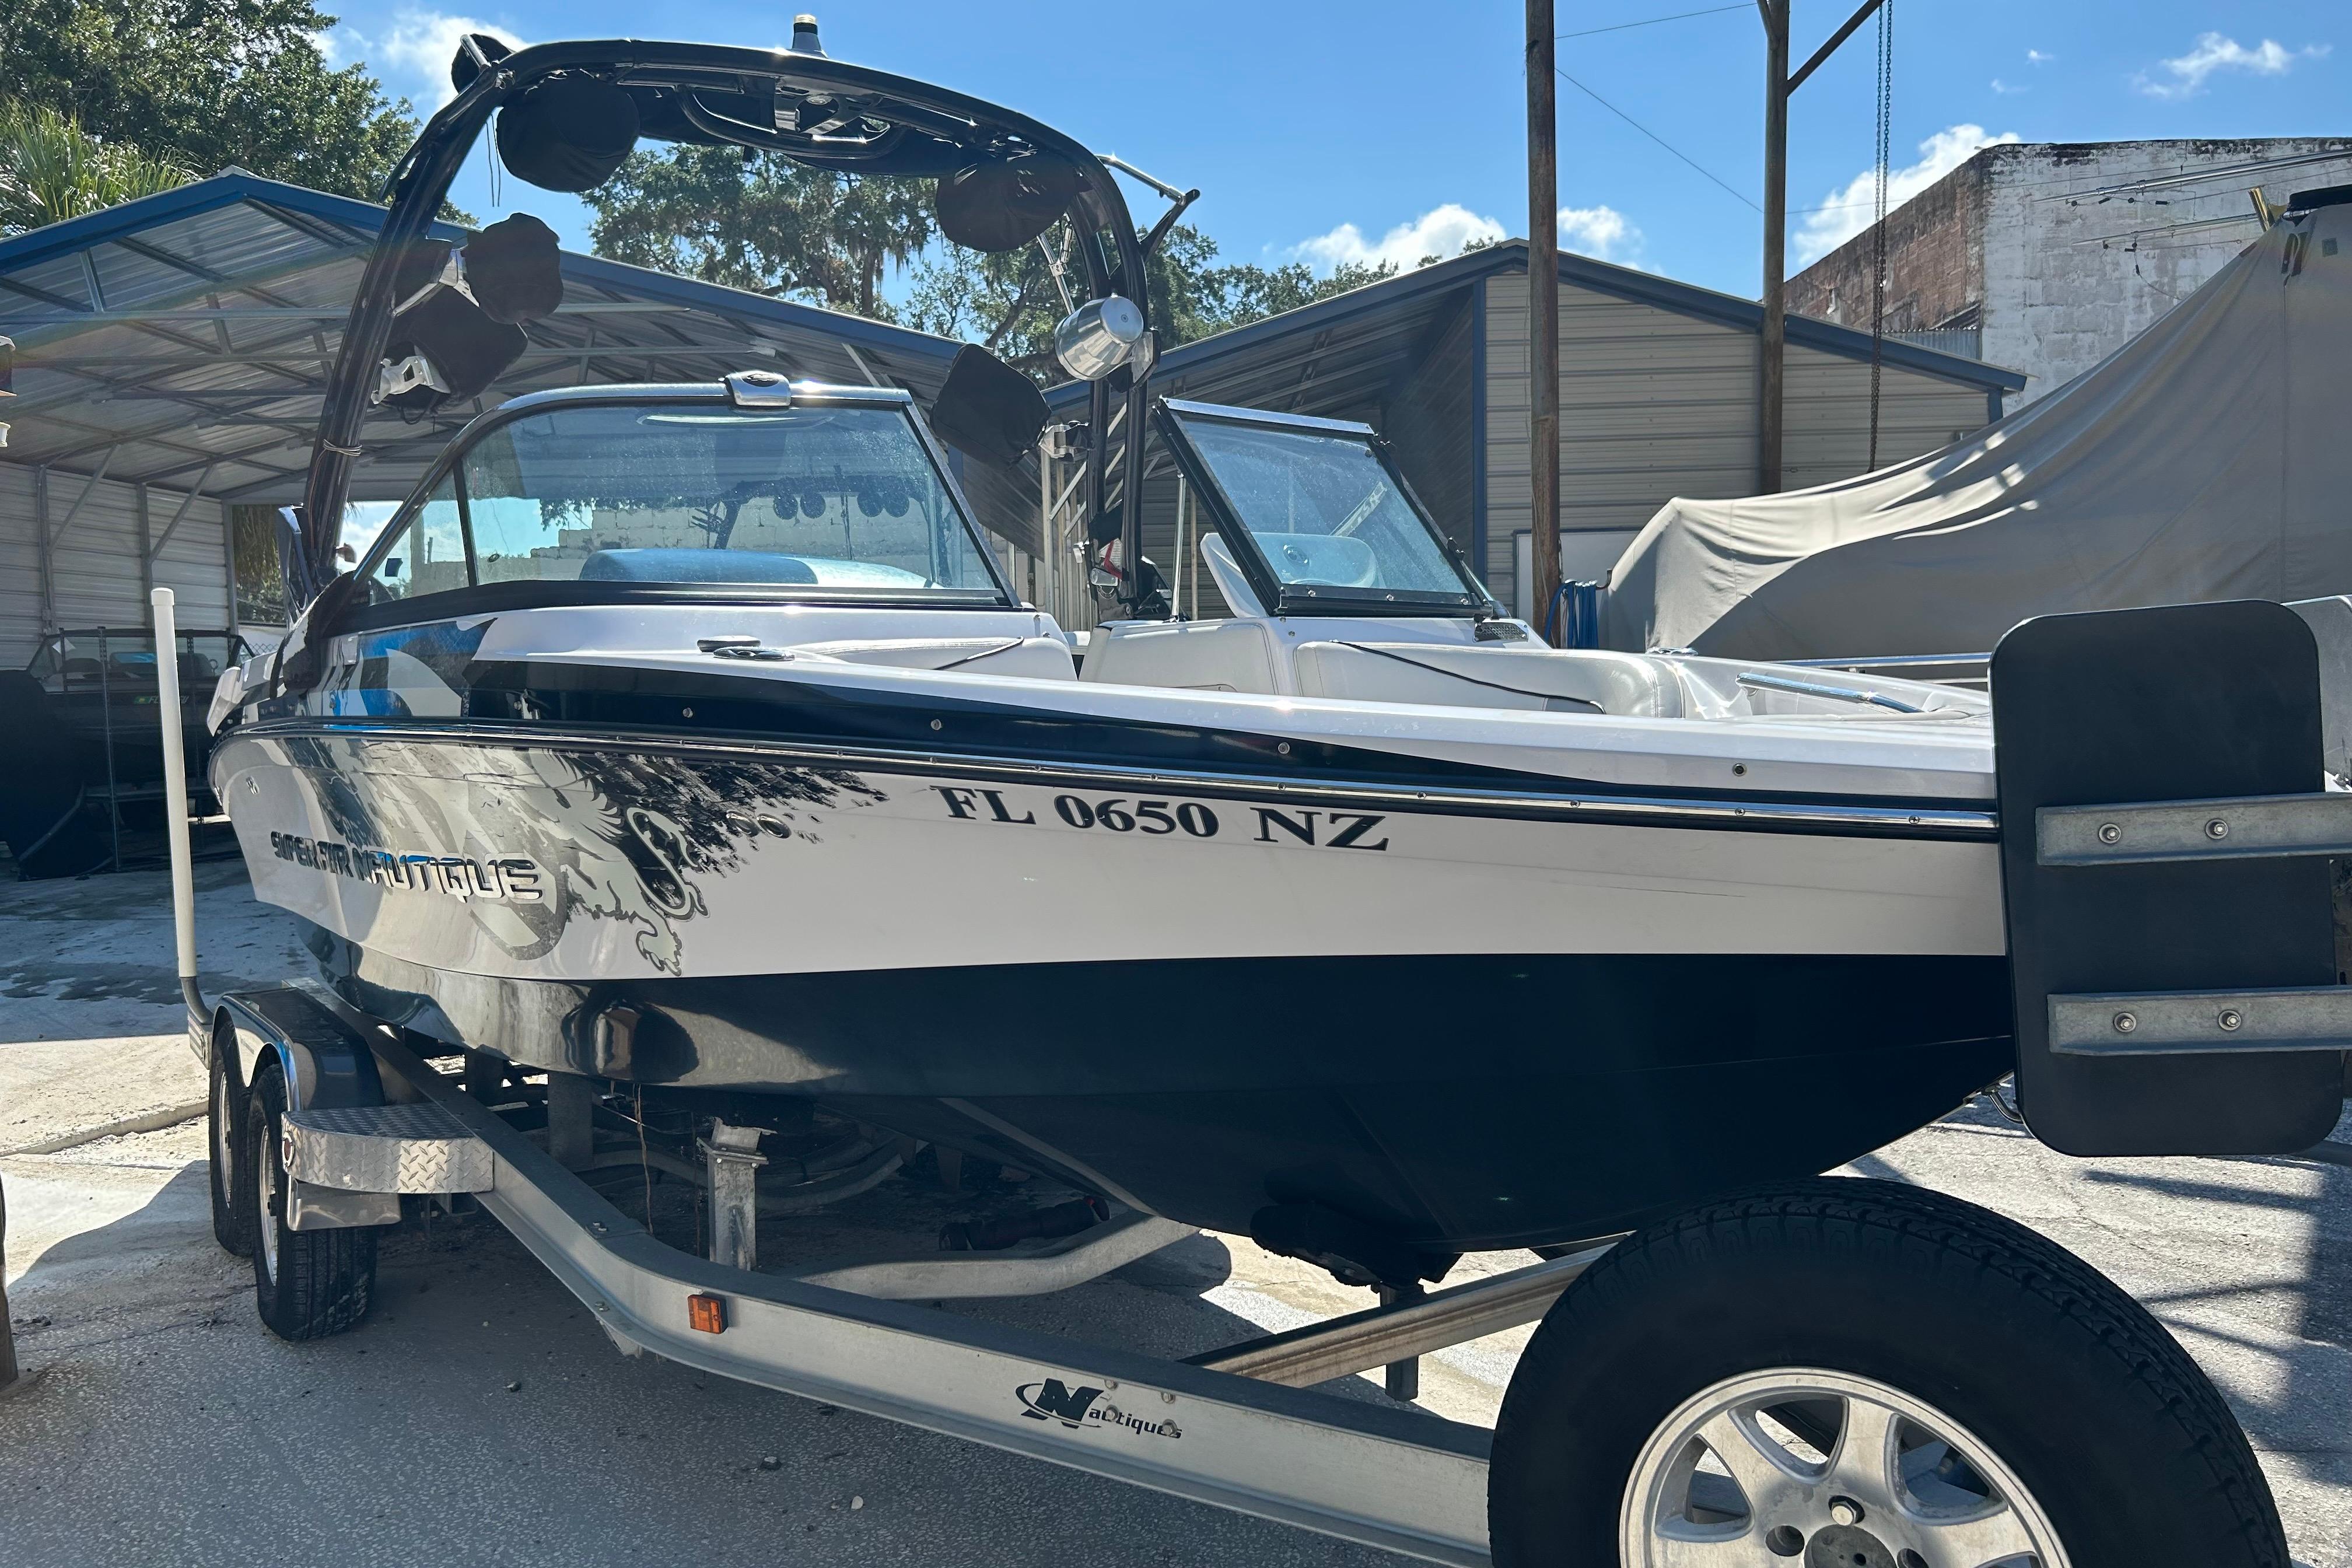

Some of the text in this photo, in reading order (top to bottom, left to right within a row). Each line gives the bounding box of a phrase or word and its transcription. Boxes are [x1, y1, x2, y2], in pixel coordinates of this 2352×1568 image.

[930, 785, 1389, 851] FL 0650 NZ
[352, 849, 543, 902] NAUTIQUE
